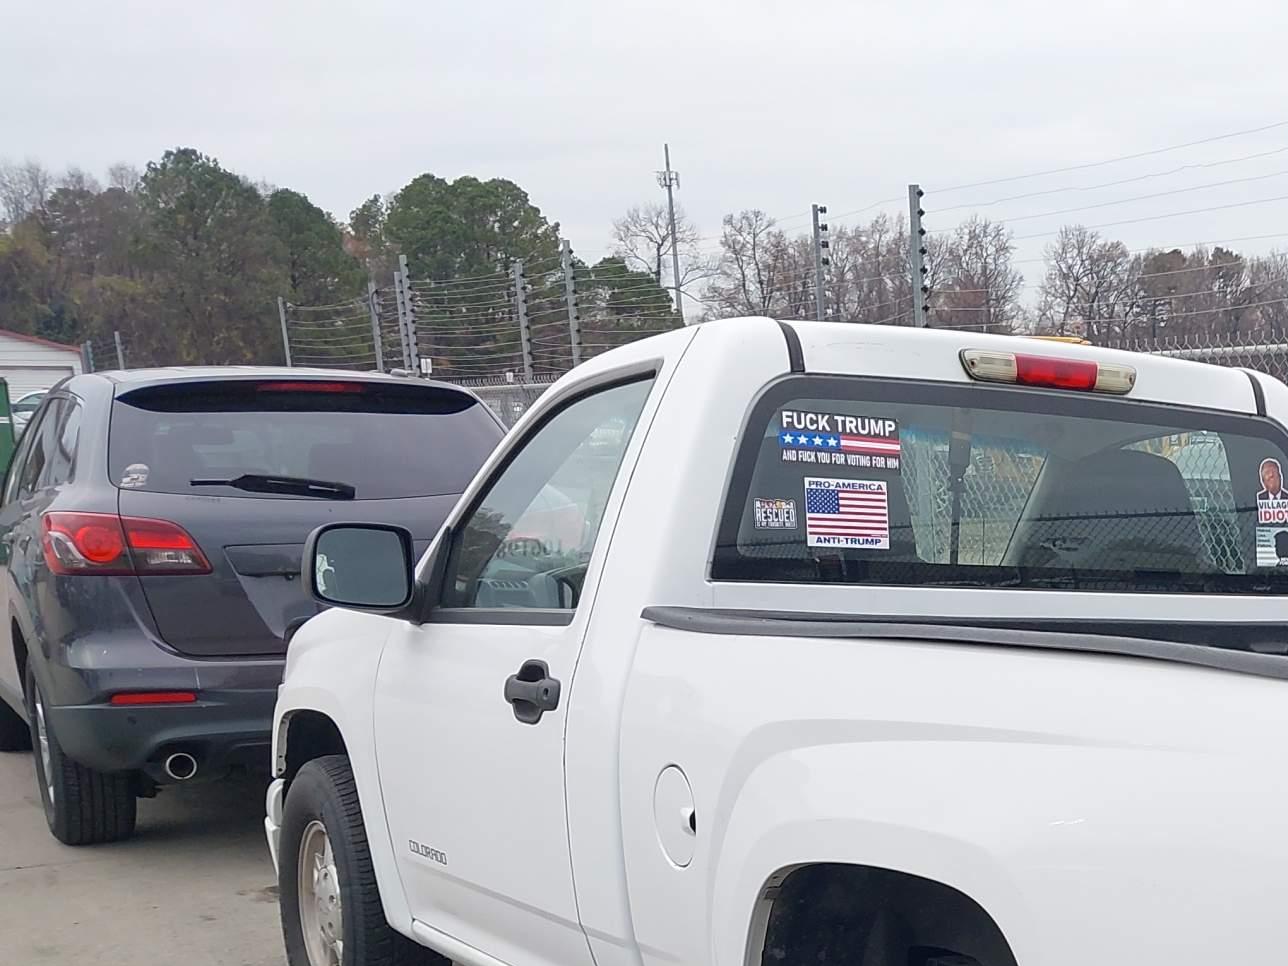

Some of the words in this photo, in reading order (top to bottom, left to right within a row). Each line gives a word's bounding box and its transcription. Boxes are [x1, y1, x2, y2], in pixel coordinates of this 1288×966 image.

[781, 410, 831, 431] FUCK
[833, 415, 896, 437] TRUMP
[782, 449, 797, 461] AND
[799, 450, 816, 463] FUCK
[817, 452, 830, 464] YOU
[832, 453, 845, 465] FOR
[847, 454, 871, 467] VOTING
[872, 456, 886, 468] FOR
[887, 457, 899, 469] HIM
[808, 480, 883, 491] PRO-AMERICA
[755, 508, 795, 522] RESCUED
[815, 536, 882, 546] ANTI-TRUMP
[408, 839, 448, 865] COLORADO
